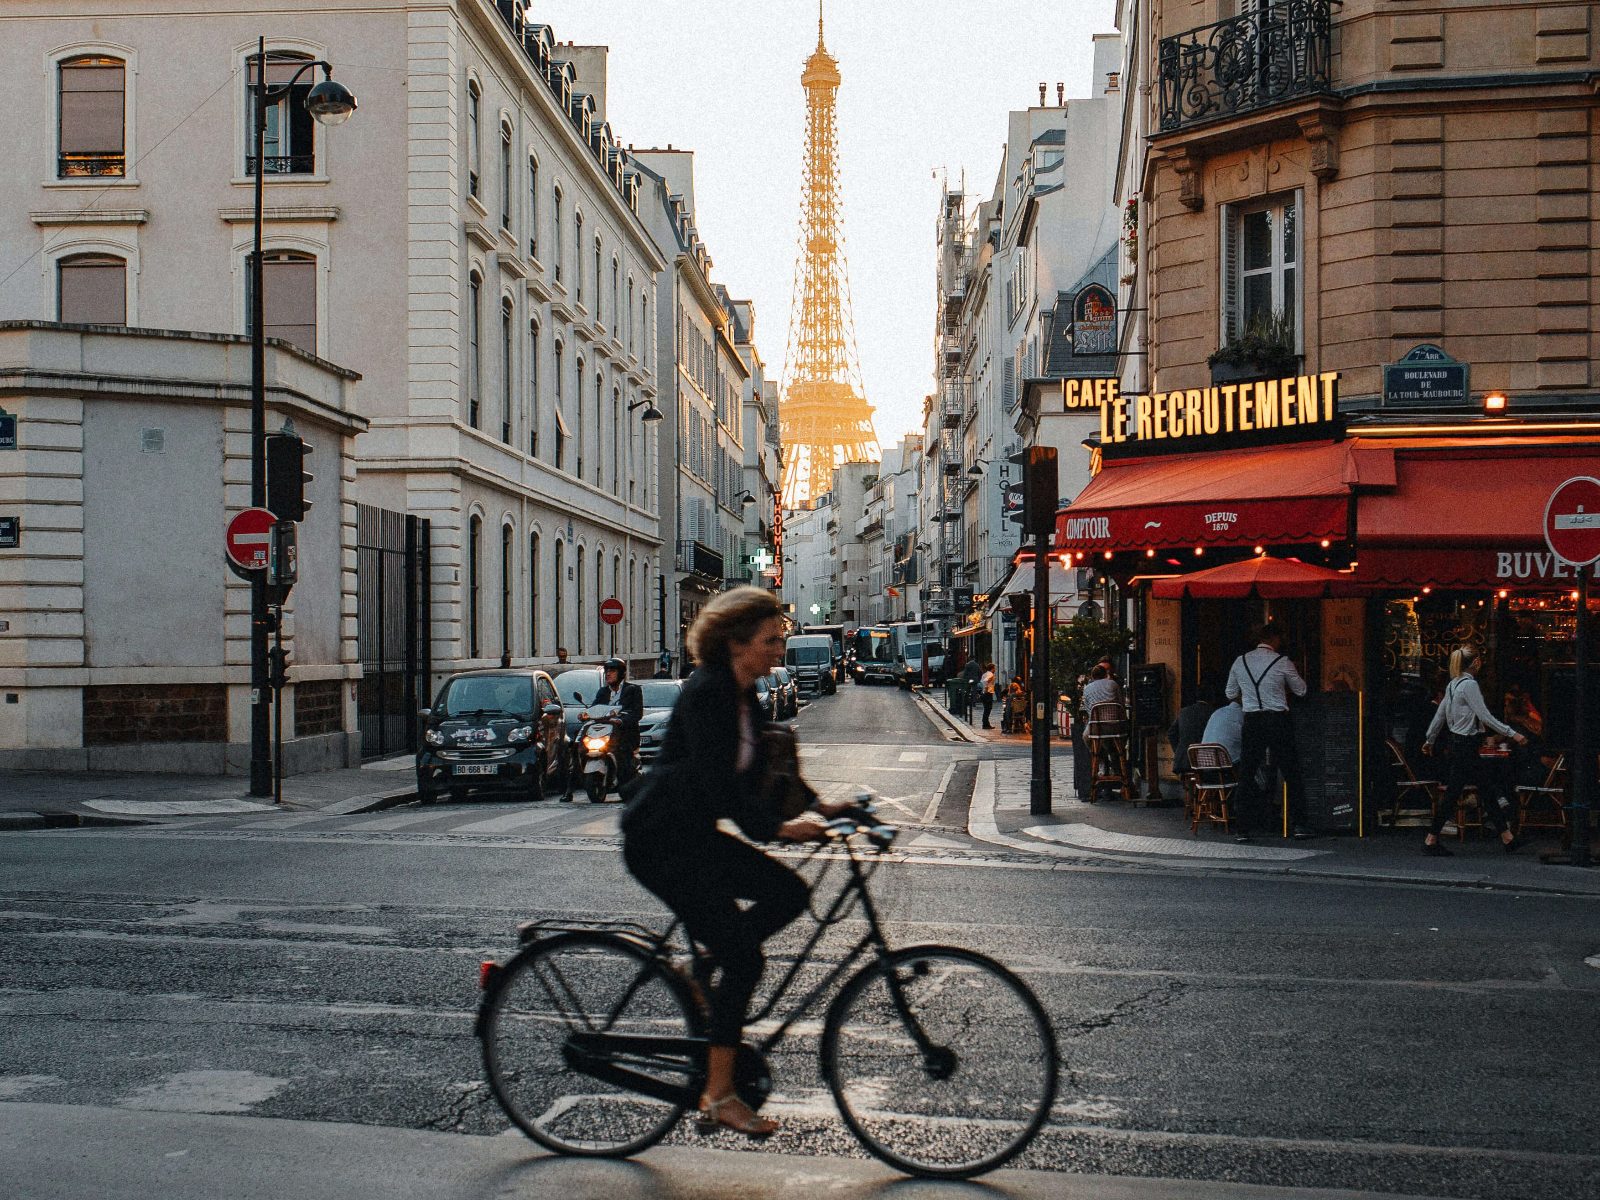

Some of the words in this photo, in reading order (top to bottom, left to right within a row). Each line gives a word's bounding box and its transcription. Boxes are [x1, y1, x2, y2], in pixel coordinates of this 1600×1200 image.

[1404, 371, 1448, 380] BOULEVARD
[1420, 381, 1432, 389] DE
[1066, 379, 1119, 408] CAFE
[1388, 391, 1398, 399] LA
[1399, 389, 1464, 399] TOUR-MAUBOURG
[1101, 399, 1127, 444] LE
[1137, 371, 1338, 441] RECRUTEMENT
[1204, 511, 1238, 524] DEPUIS
[1066, 516, 1111, 540] COMPTOIR
[1212, 523, 1229, 531] 1870
